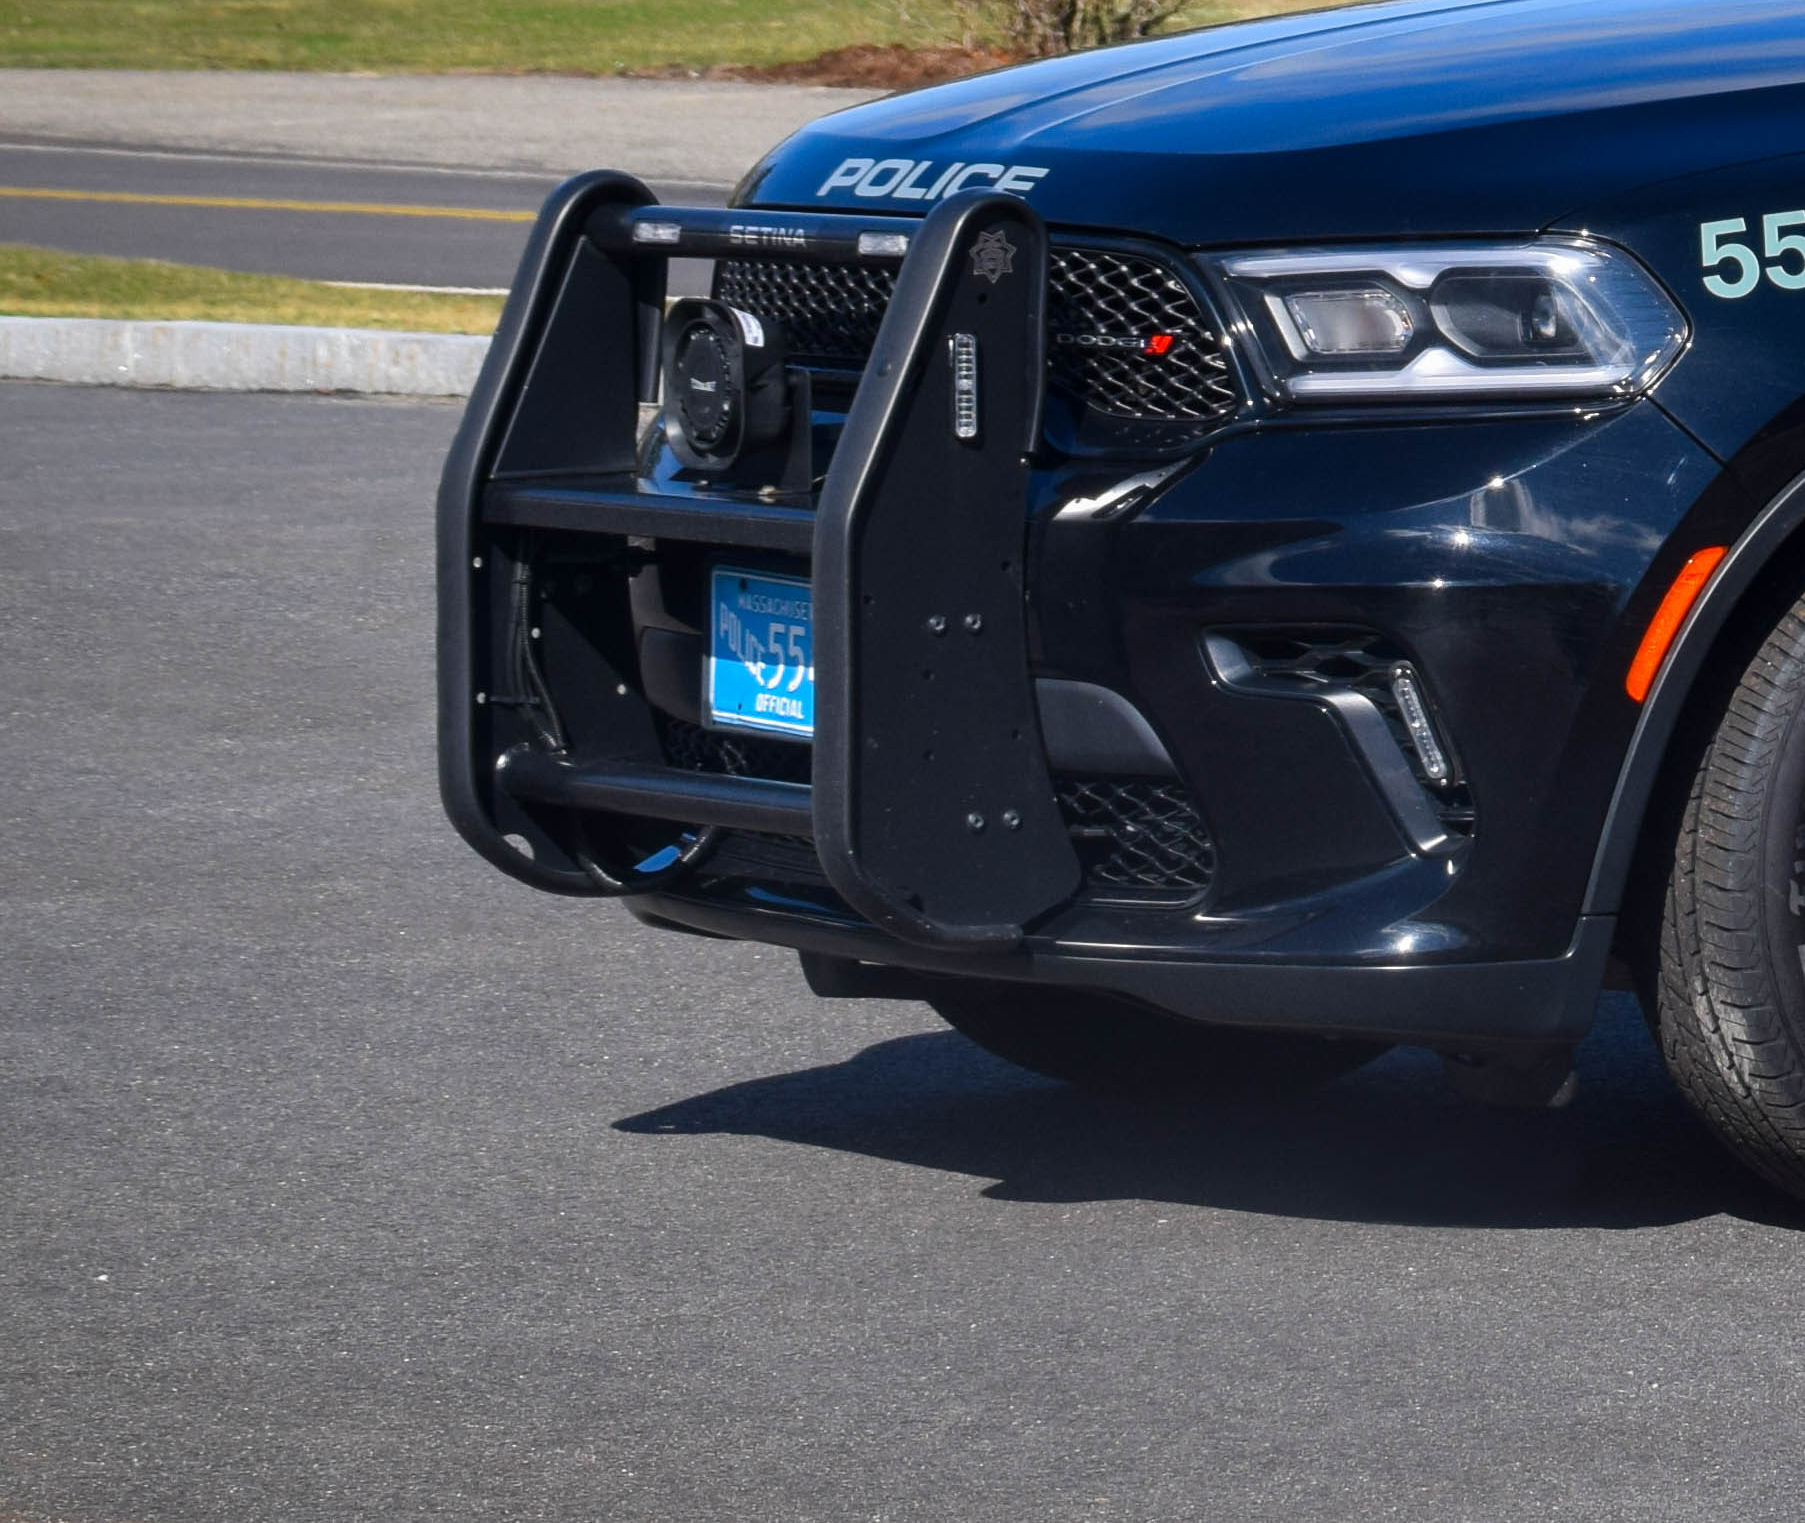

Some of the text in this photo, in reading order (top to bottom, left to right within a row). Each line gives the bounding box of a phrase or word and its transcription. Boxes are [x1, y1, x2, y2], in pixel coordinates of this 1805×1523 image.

[816, 157, 1050, 201] POLICE
[729, 224, 807, 248] SETINA
[719, 602, 766, 687] POLICE
[766, 622, 814, 693] 55
[755, 693, 805, 719] OFFICIAL
